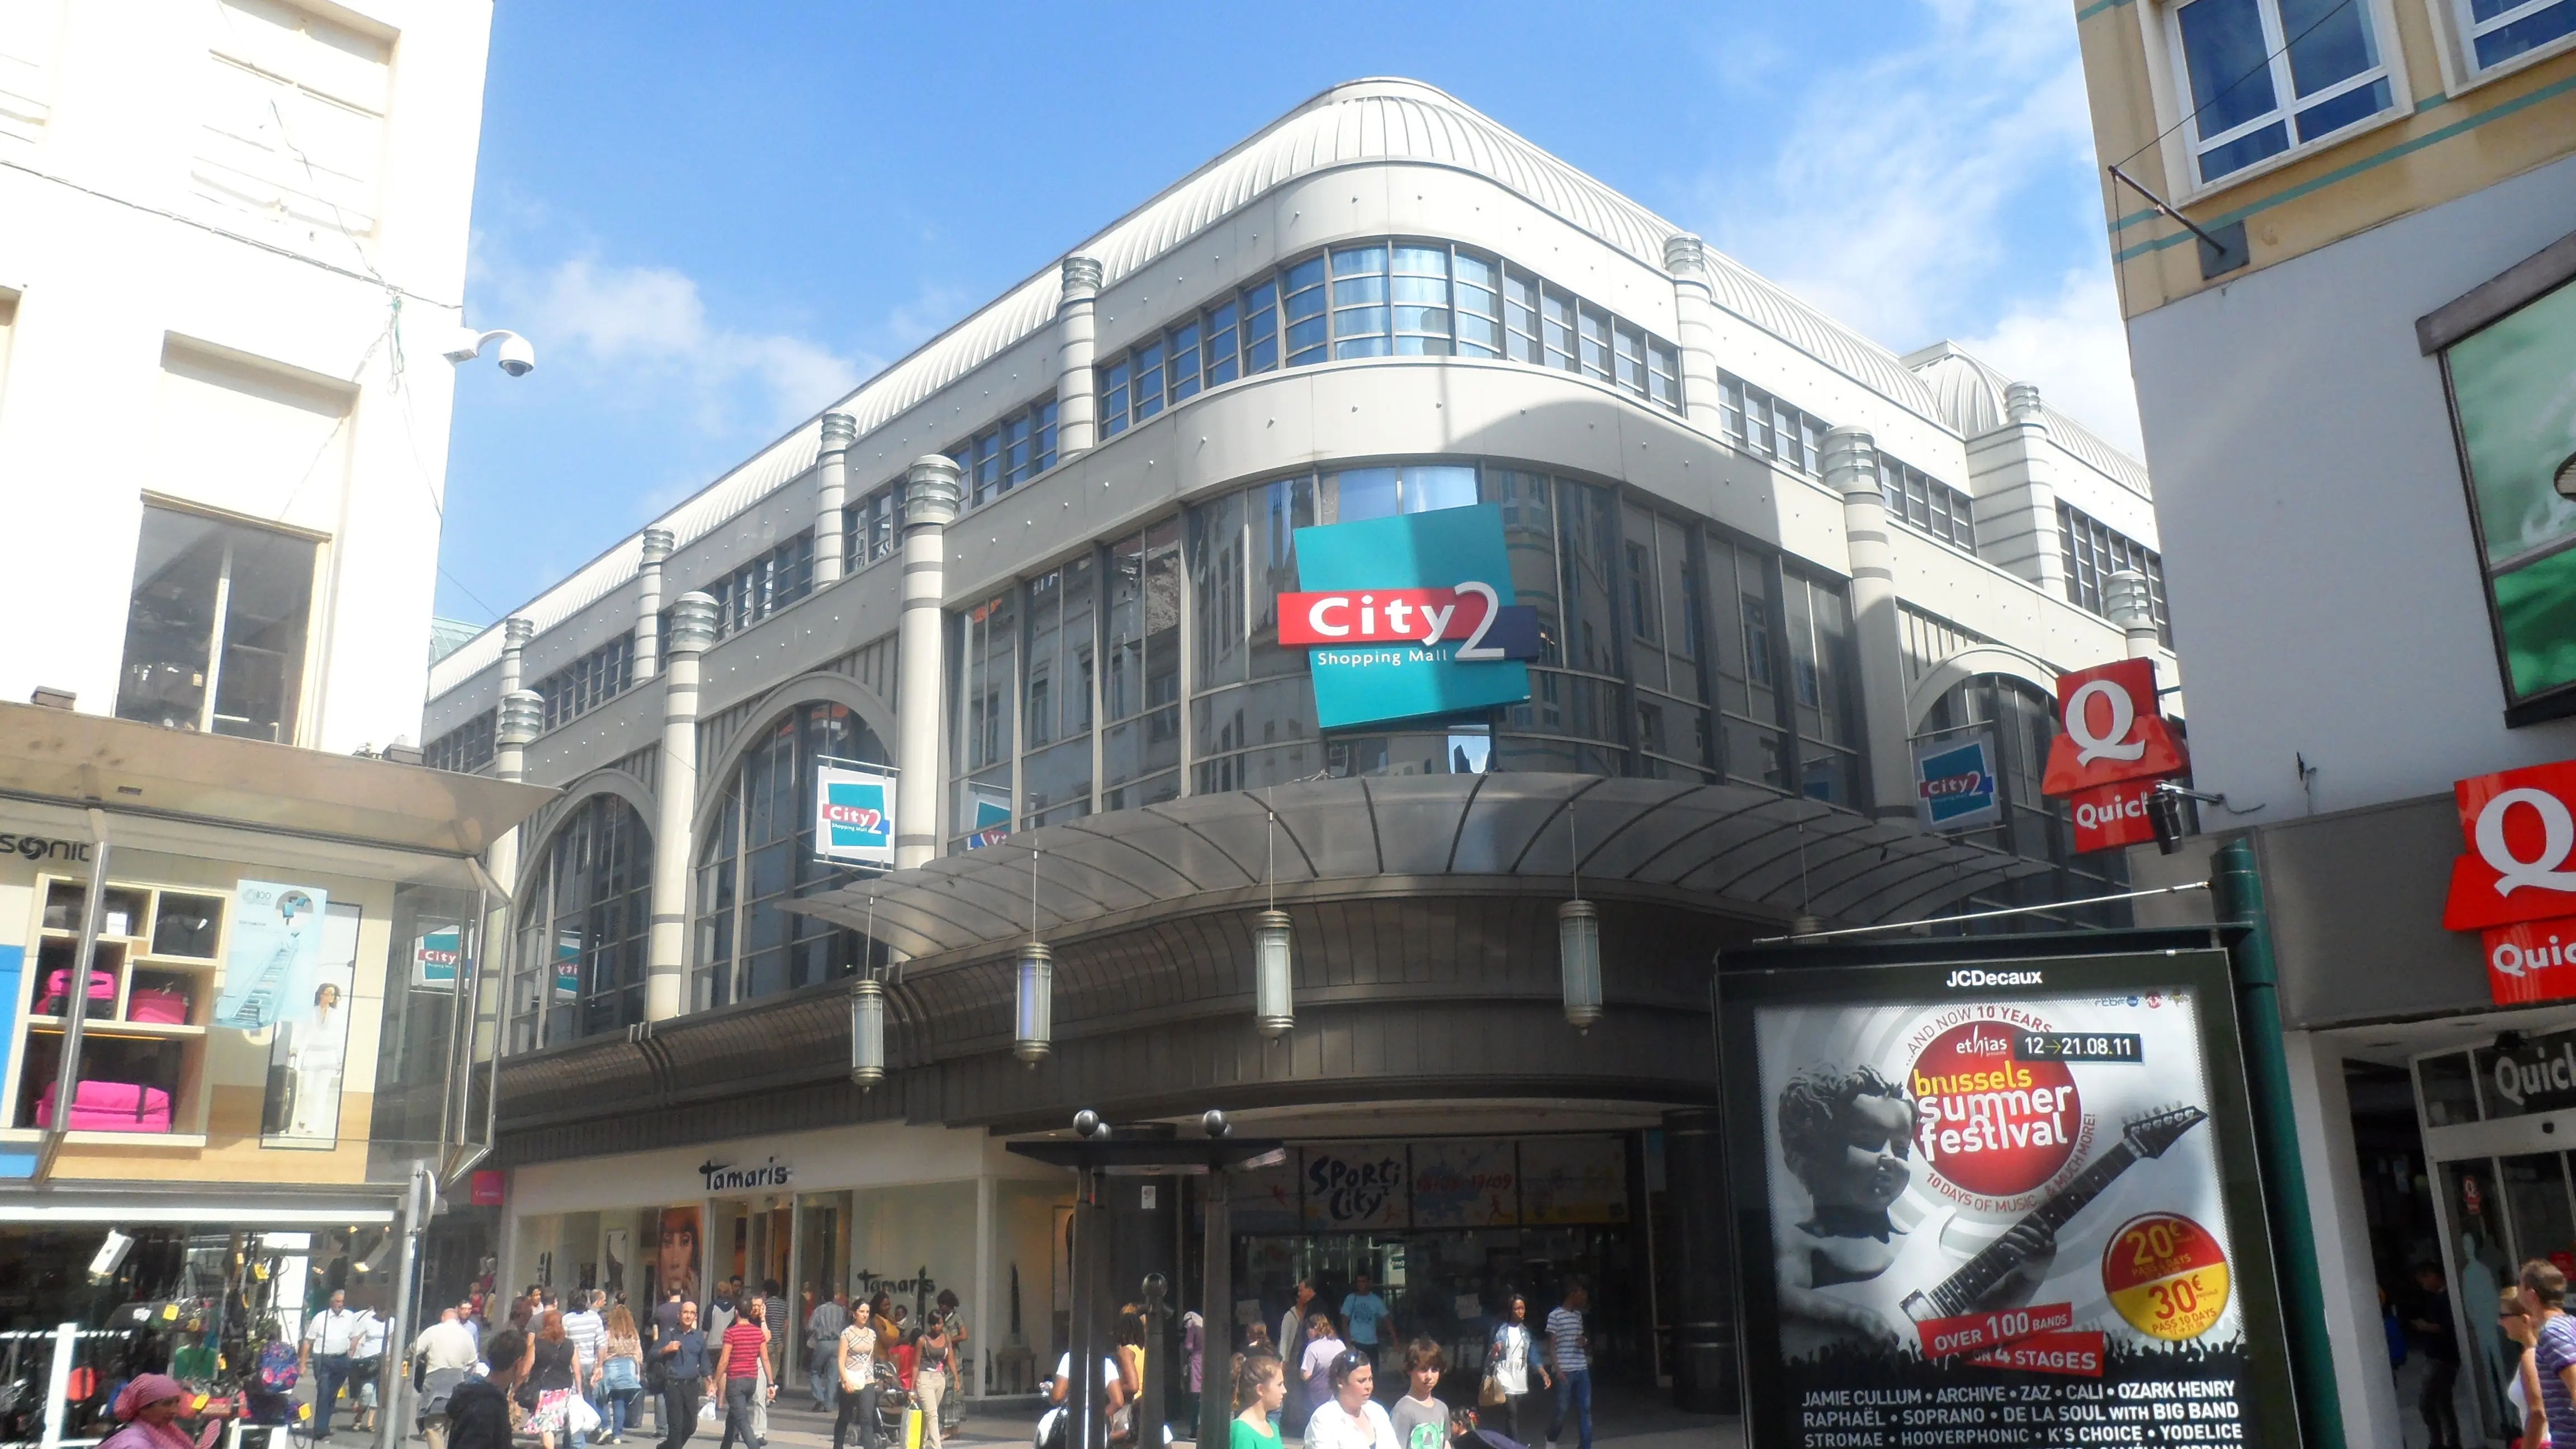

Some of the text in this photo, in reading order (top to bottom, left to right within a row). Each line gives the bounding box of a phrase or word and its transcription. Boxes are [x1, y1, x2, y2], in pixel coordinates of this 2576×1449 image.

[1318, 648, 1447, 669] Shopping Mall
[2066, 680, 2146, 767] Q
[831, 823, 855, 832] Shopping
[425, 951, 457, 965] City
[1946, 970, 2042, 987] JCDecaux
[1935, 1006, 1972, 1030] NOW
[1977, 1006, 1995, 1019] 10
[2001, 1006, 2053, 1033] YEARS
[1956, 1025, 2007, 1058] ethias
[2024, 1037, 2131, 1055] 12 21.08.11
[1914, 1060, 2033, 1096] brussels
[1918, 1085, 2073, 1123] summer
[1920, 1112, 2068, 1162] festival
[1926, 1172, 1942, 1189] 10
[1939, 1183, 1972, 1206] DAYS
[1974, 1198, 1992, 1212] OF
[1995, 1194, 2037, 1213] MUSIC
[2055, 1156, 2085, 1190] MUCH
[2078, 1113, 2096, 1158] MORE!
[1934, 1311, 2068, 1351] OVER 100 BANDS
[2152, 1306, 2217, 1334] PASS 10 DAYS
[1994, 1347, 2011, 1364] 4
[2015, 1350, 2097, 1370] STAGES
[1802, 1380, 2236, 1408] JAMIE CULLUM ARCHIVE ZAZ CALI OZARK HENRY
[1803, 1401, 2239, 1428] RAPHAËL SOPRANO DE LA SOUL WITH BIG BAND
[1804, 1423, 2244, 1448] STROMAE HOOVERPHONIC K'S CHOICE YODELICE
